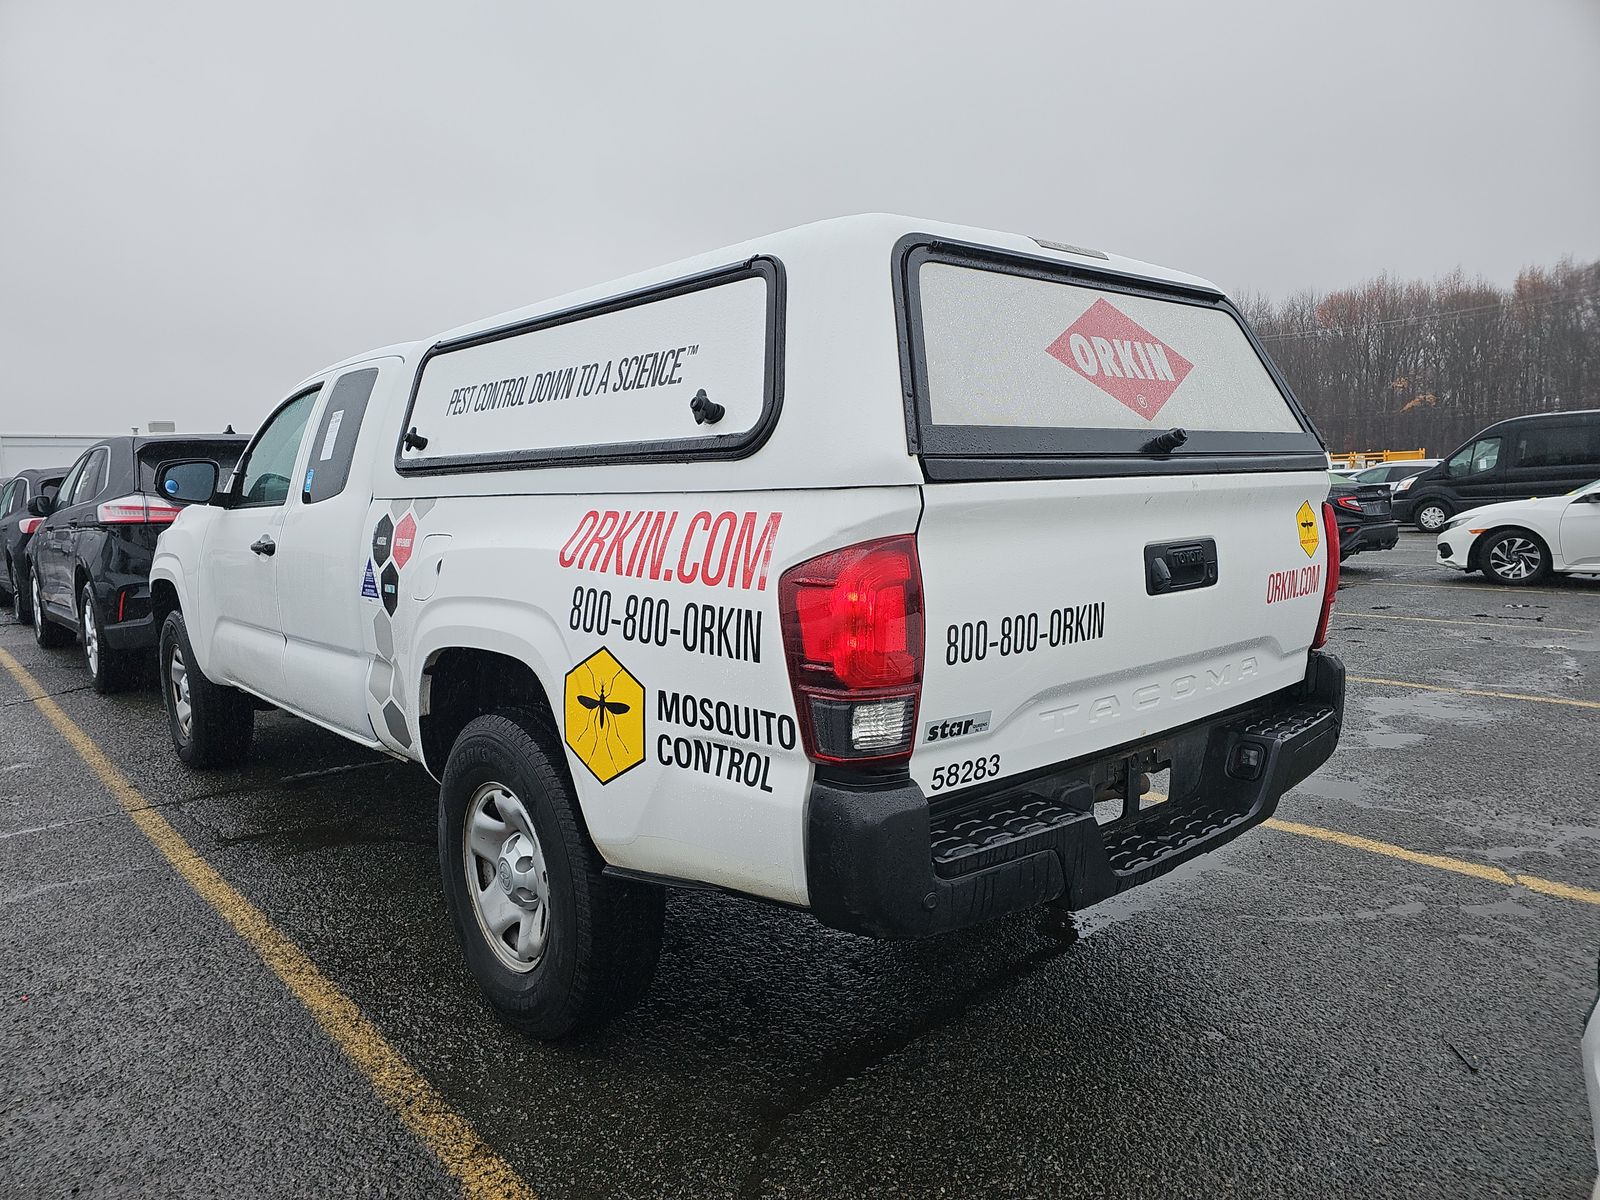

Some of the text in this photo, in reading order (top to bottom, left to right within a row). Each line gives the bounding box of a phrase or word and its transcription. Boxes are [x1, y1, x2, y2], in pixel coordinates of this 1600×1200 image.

[1069, 333, 1176, 382] ORKIN
[446, 385, 477, 416] PEST
[474, 376, 529, 413] CONTROL
[528, 367, 578, 404] DOWN
[576, 363, 599, 398] TO
[595, 360, 612, 395] A
[559, 510, 783, 591] ORKIN.COM
[1266, 564, 1321, 604] ORKIN.COM
[569, 585, 763, 663] 800-800-ORKIN
[946, 601, 1105, 666] 800-800-ORKIN
[657, 689, 797, 751] MOSQUITO
[1039, 656, 1259, 733] TACOMA
[927, 719, 974, 741] star
[657, 733, 773, 793] CONTROL
[930, 753, 1001, 791] 58283
